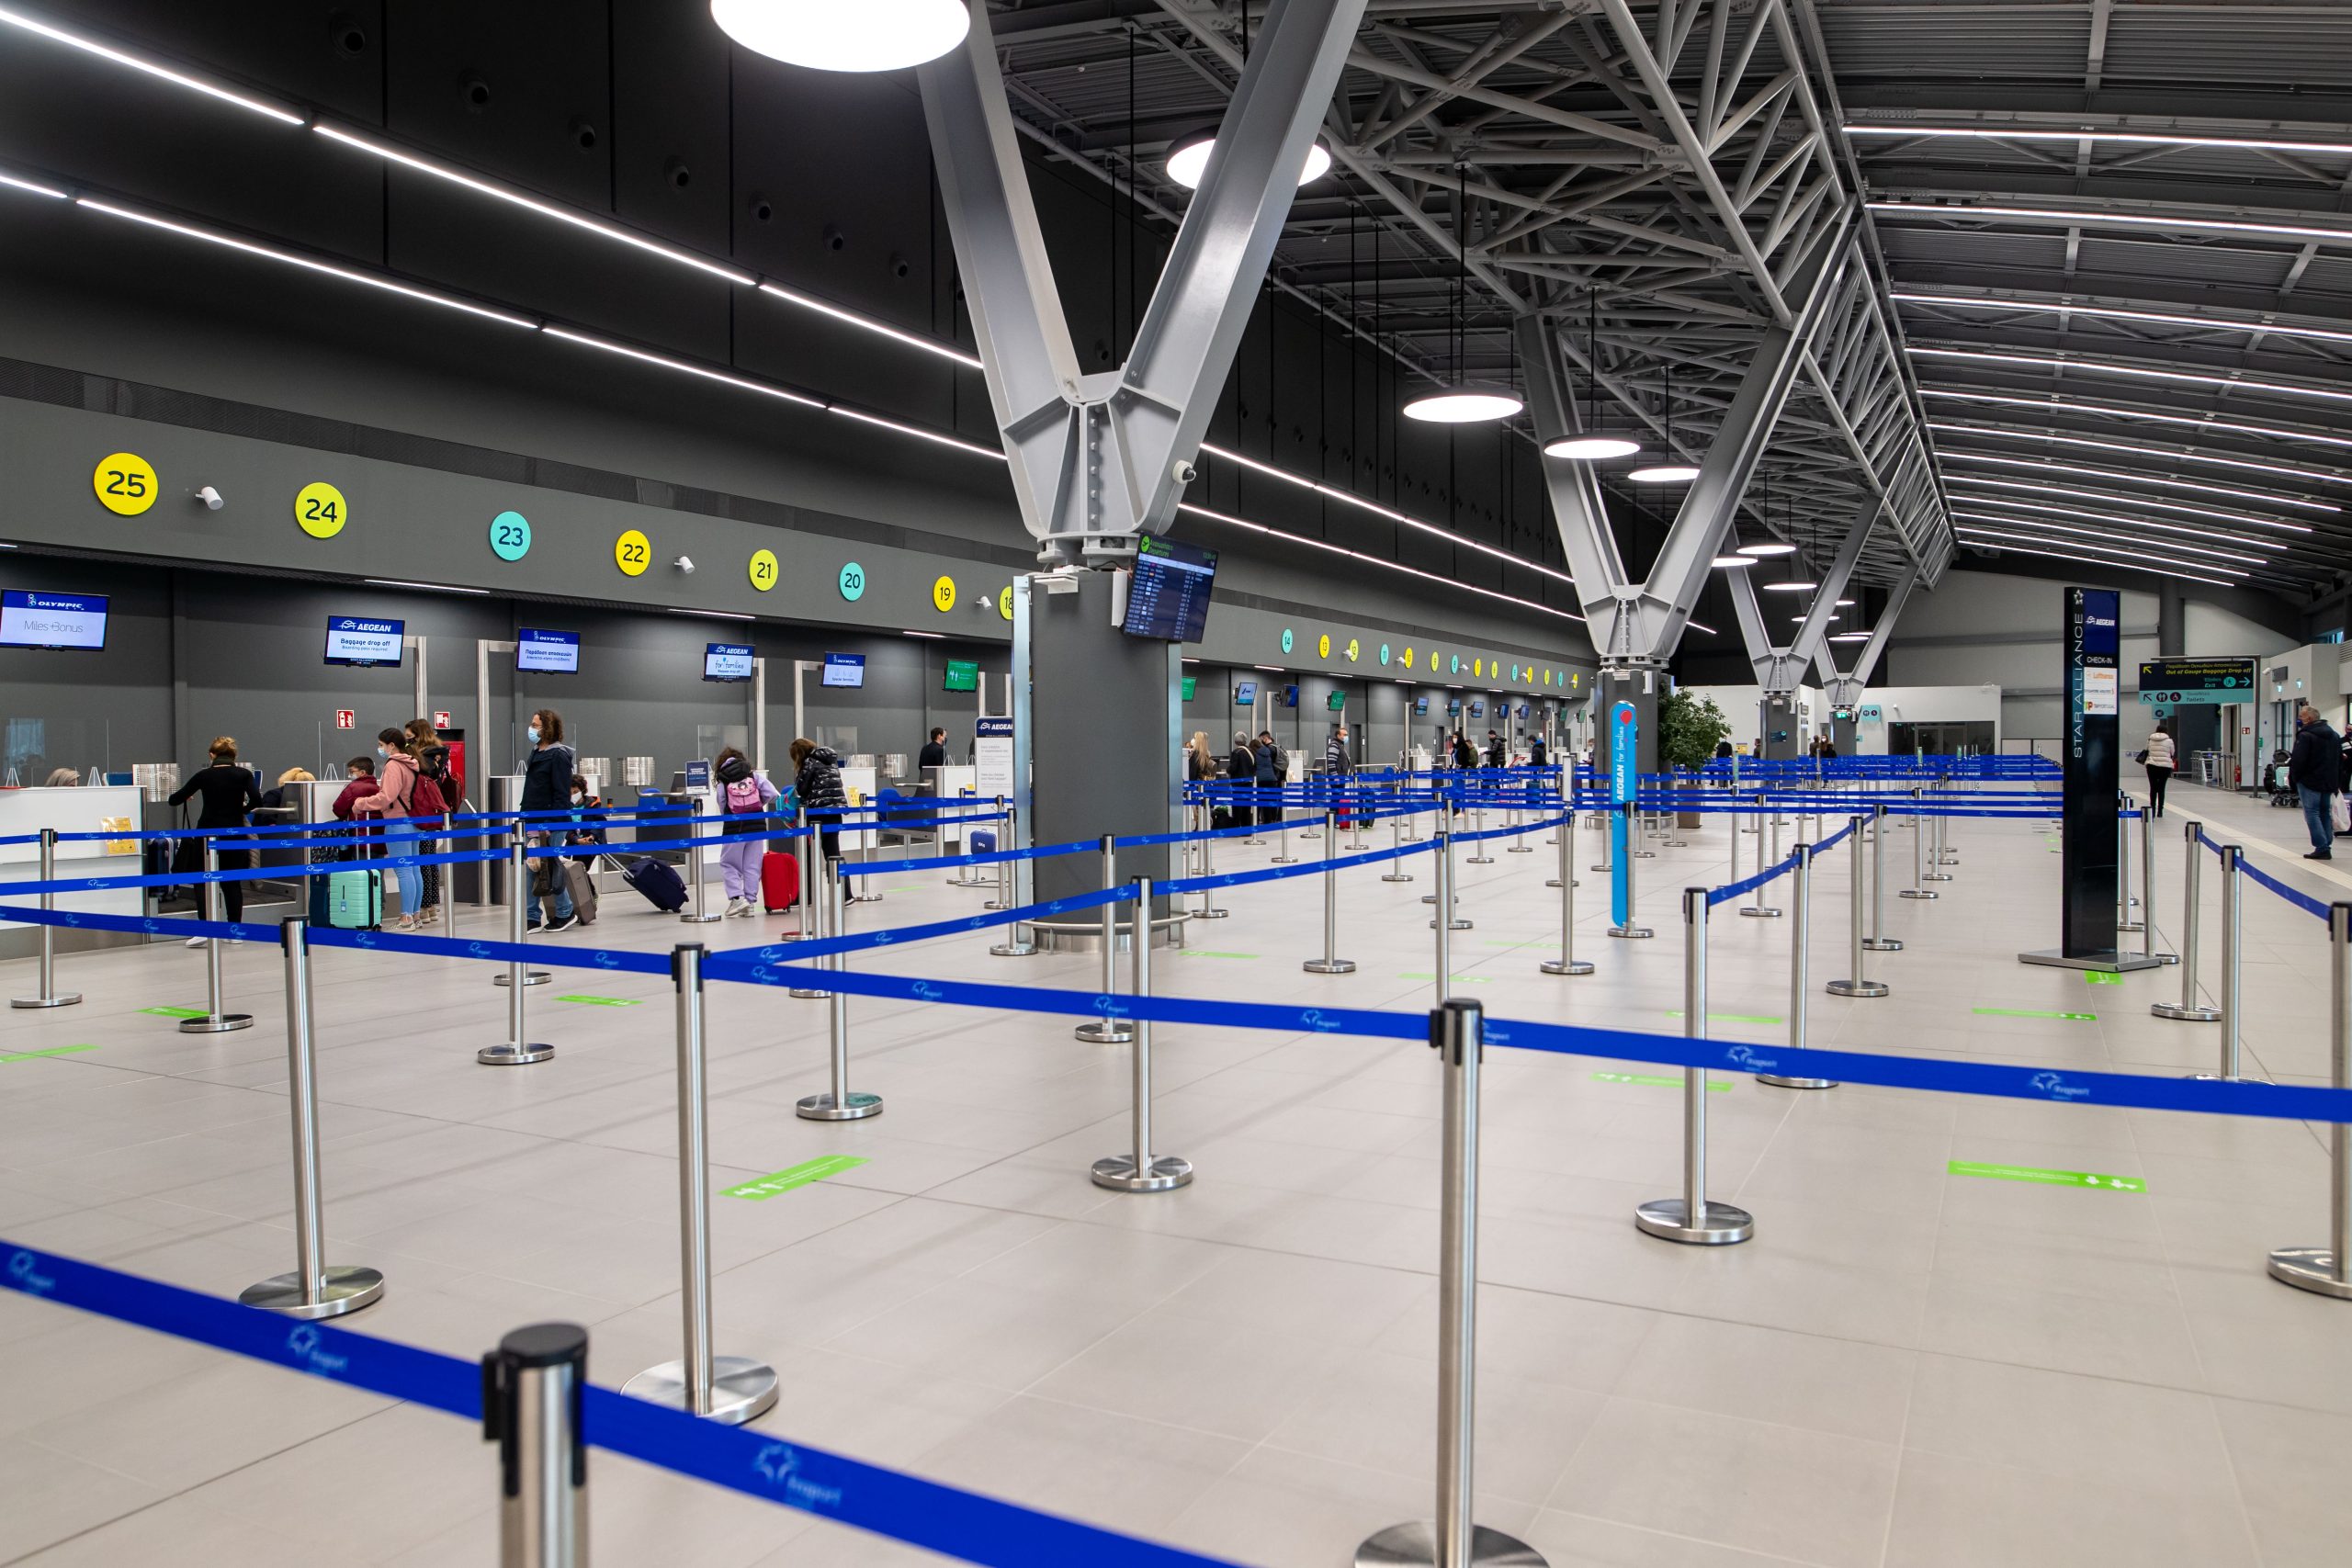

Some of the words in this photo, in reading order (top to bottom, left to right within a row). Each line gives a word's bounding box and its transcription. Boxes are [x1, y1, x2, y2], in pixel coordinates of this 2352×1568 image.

[106, 470, 146, 498] 25
[305, 499, 338, 524] 24
[498, 525, 524, 547] 23
[622, 544, 644, 564] 22
[756, 561, 772, 580] 21
[844, 572, 861, 590] 20
[940, 587, 951, 601] 19
[24, 620, 50, 632] Miles
[356, 623, 391, 633] AEGEAN
[2095, 618, 2115, 626] AEGEAN
[1284, 636, 1291, 646] 14
[1322, 642, 1328, 651] 13
[2074, 613, 2084, 705] ALLIANCE
[2086, 656, 2113, 664] CHECK-IN
[1614, 726, 1625, 750] families
[2074, 711, 2083, 758] STAR
[1615, 754, 1625, 762] for
[1616, 764, 1624, 801] AEGEAN
